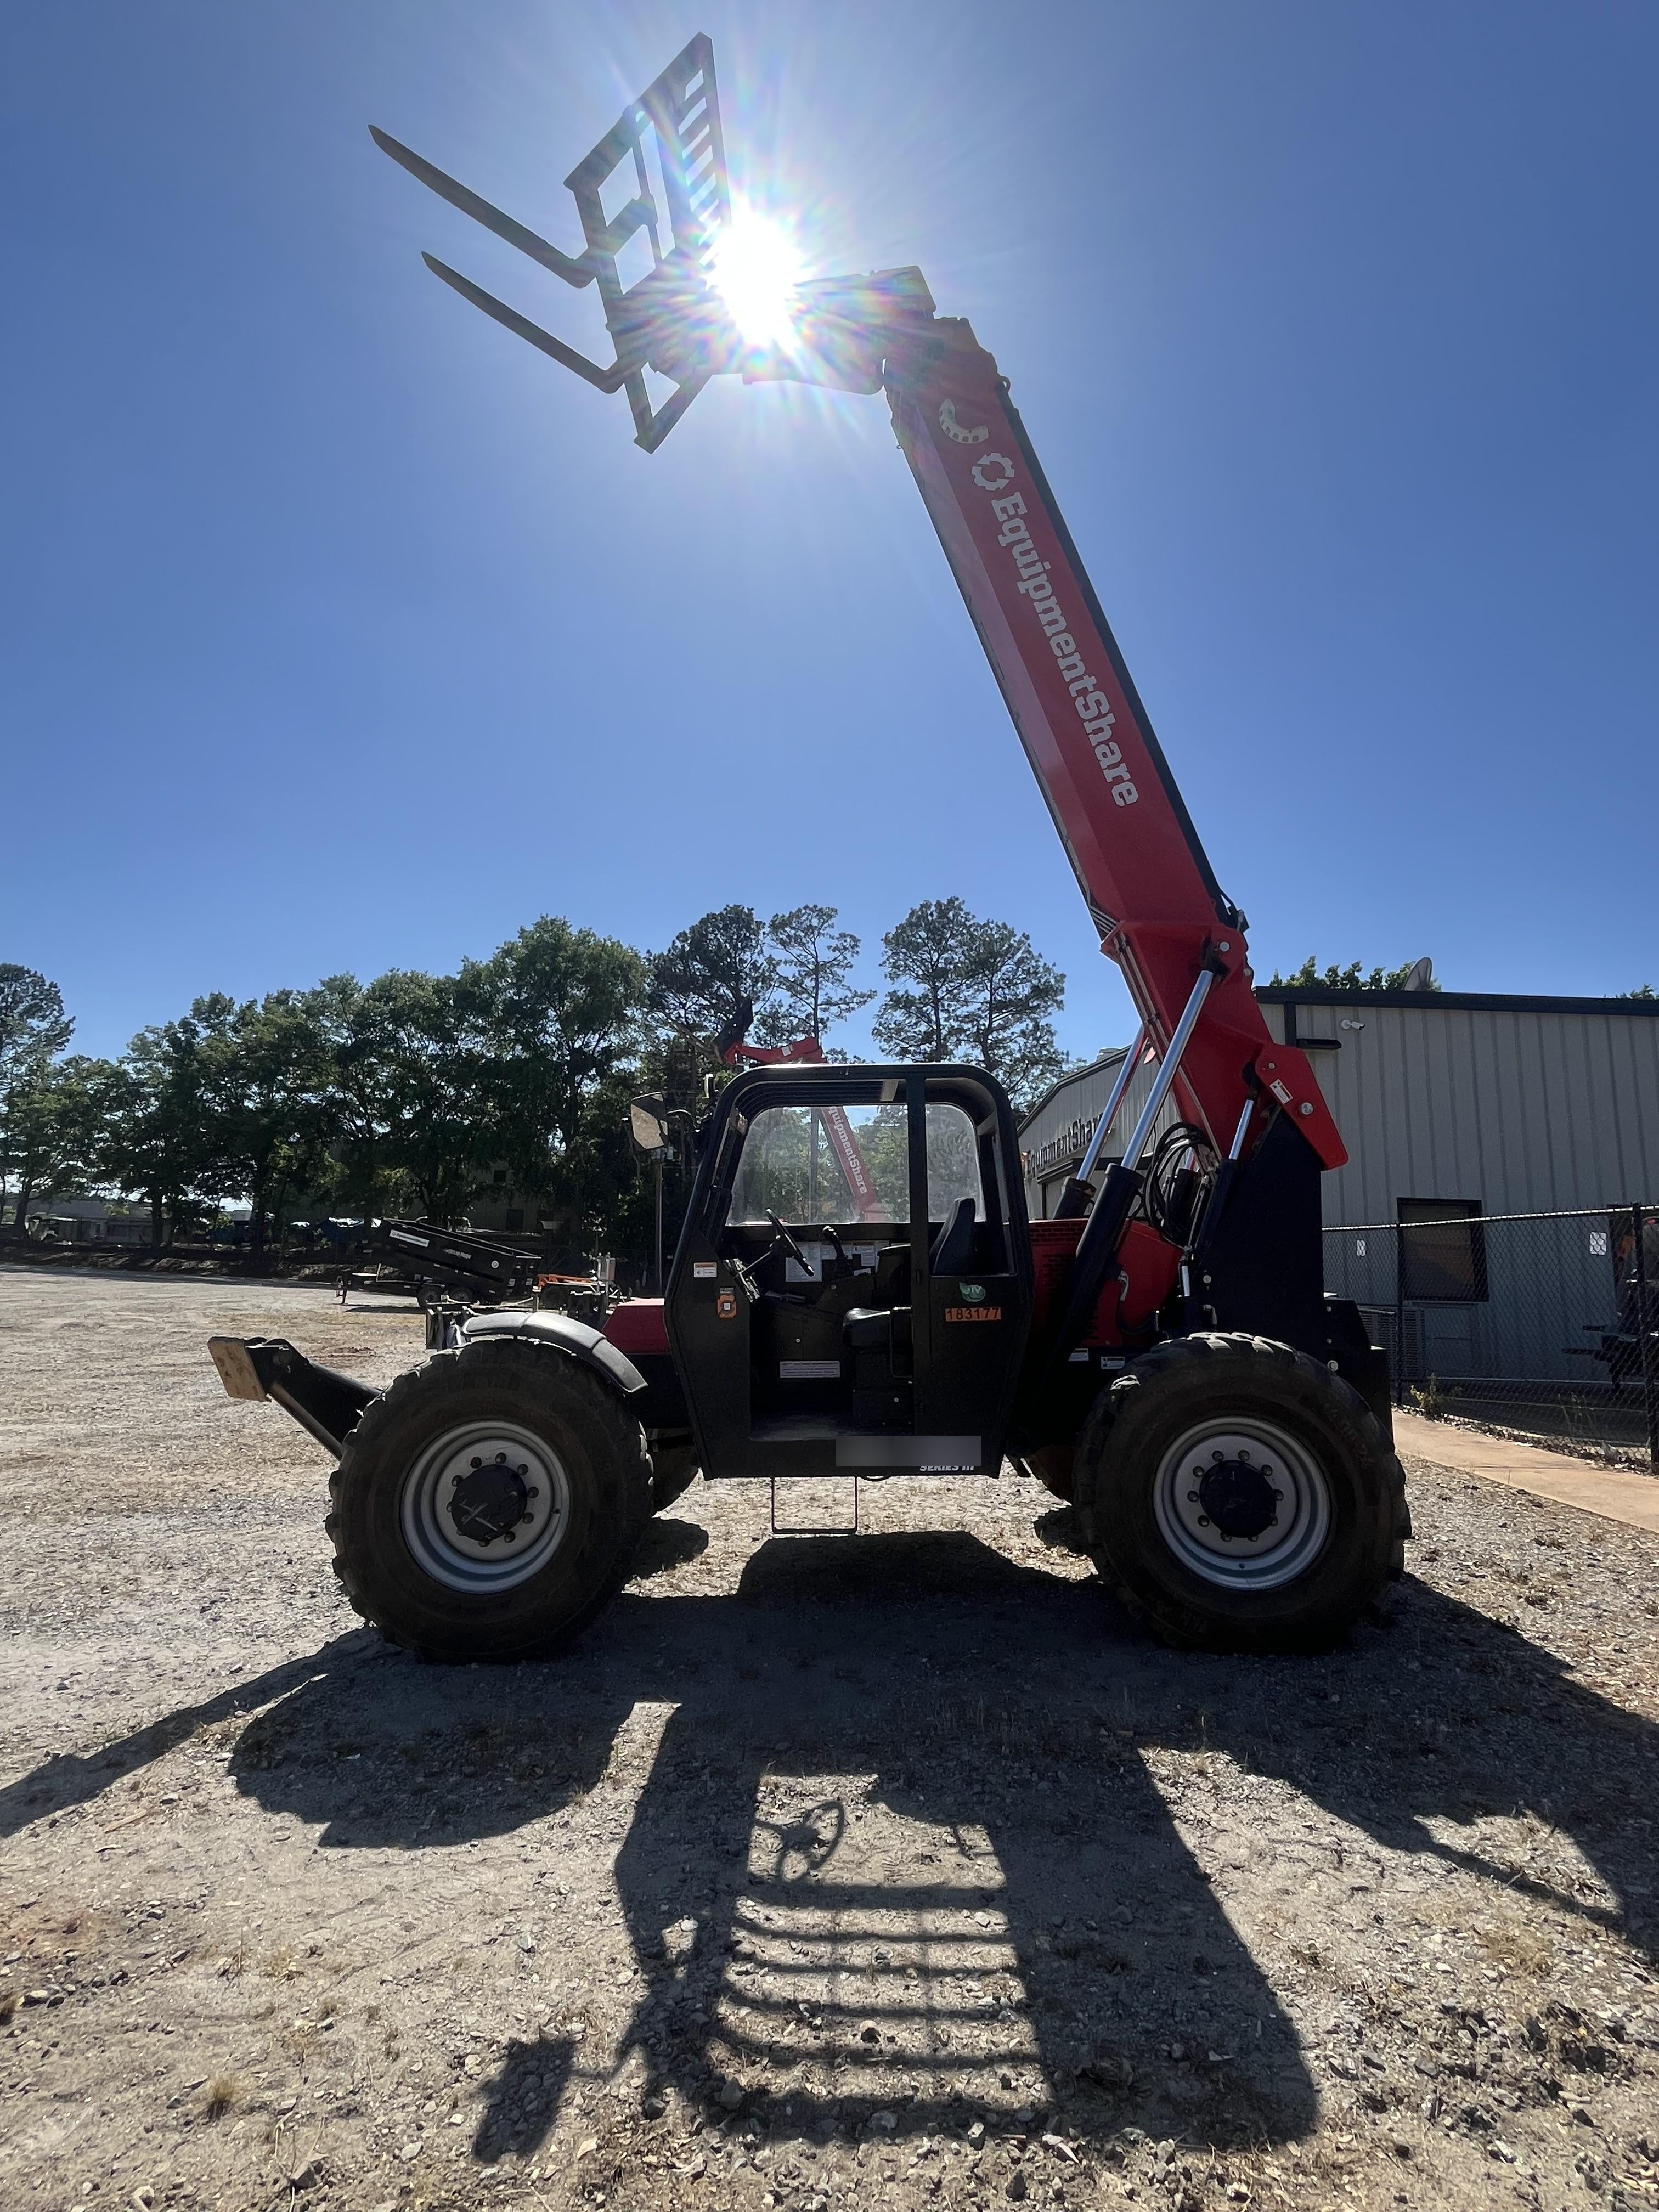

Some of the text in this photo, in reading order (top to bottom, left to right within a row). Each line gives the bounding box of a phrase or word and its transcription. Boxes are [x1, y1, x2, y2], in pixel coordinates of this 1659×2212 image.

[991, 492, 1139, 806] EquipmentShare
[828, 1106, 867, 1194] quipmentShare
[1026, 1113, 1103, 1178] EquipmentShar
[947, 1308, 1000, 1320] 183177
